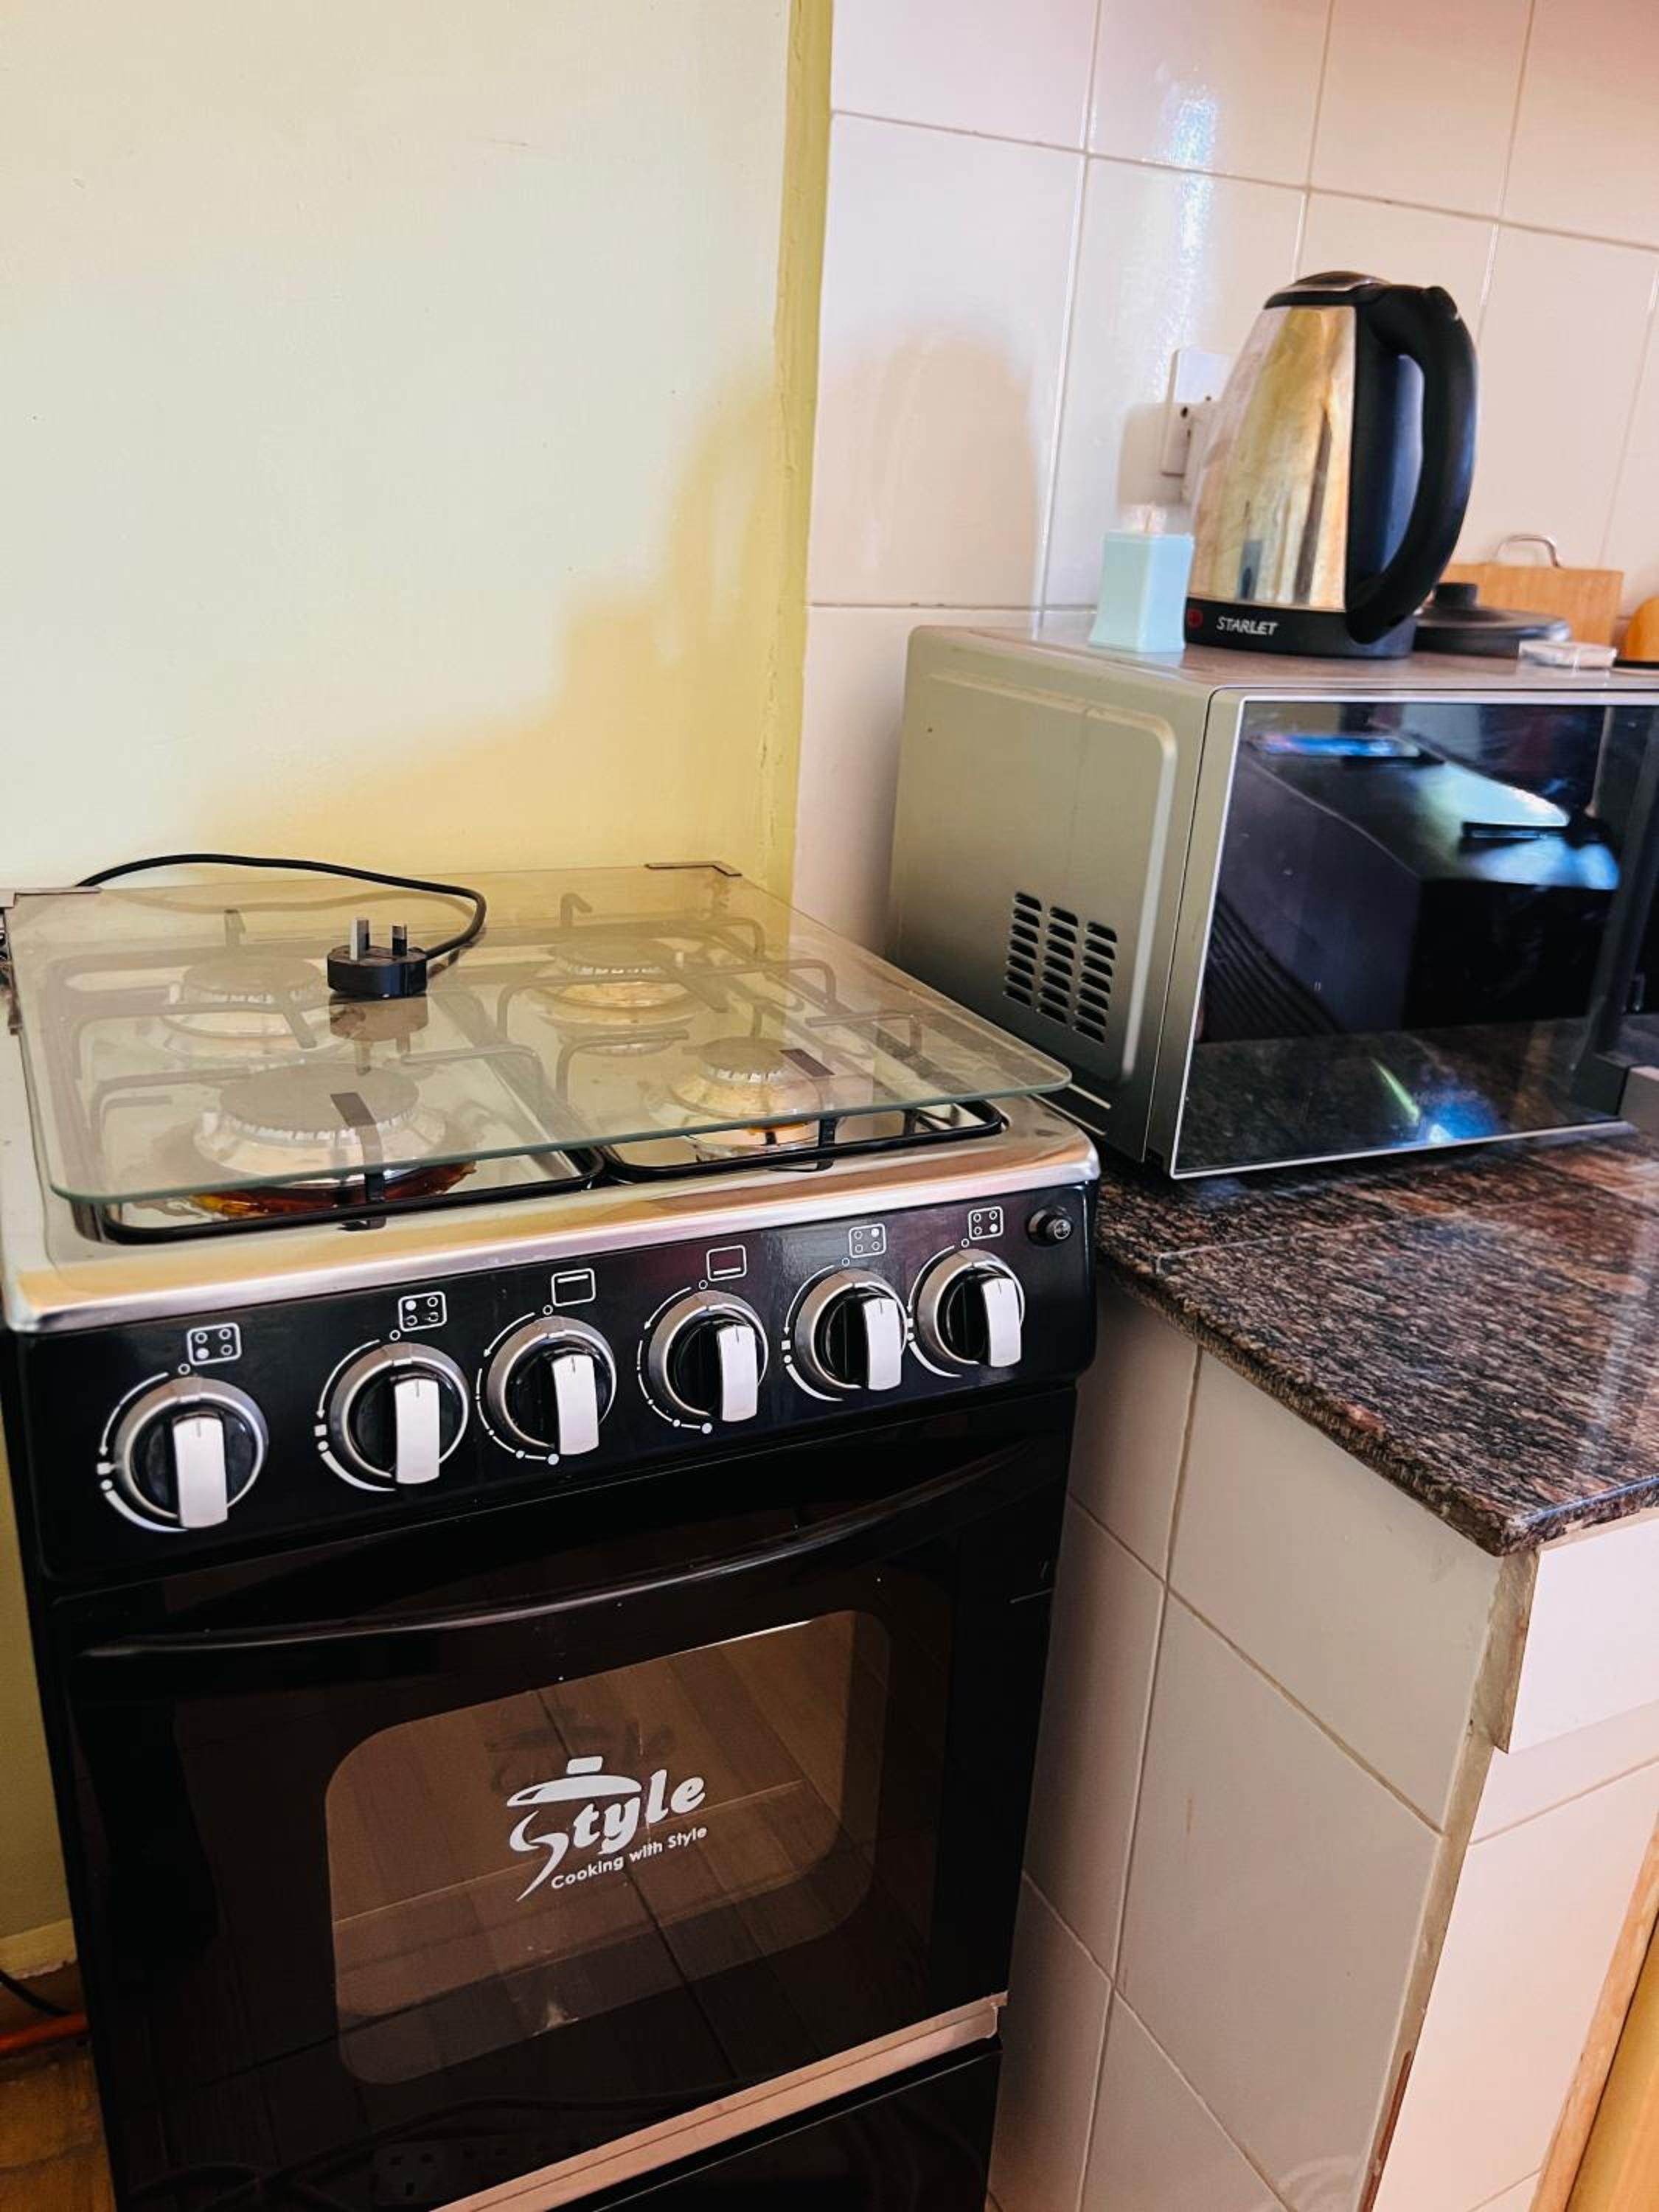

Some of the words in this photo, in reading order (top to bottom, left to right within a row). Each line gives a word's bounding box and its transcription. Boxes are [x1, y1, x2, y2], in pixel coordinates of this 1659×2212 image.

[1217, 616, 1278, 636] STARLET
[509, 1769, 706, 1901] Style
[551, 1856, 625, 1889] Cooking
[629, 1842, 664, 1863] with
[667, 1826, 708, 1849] Style
